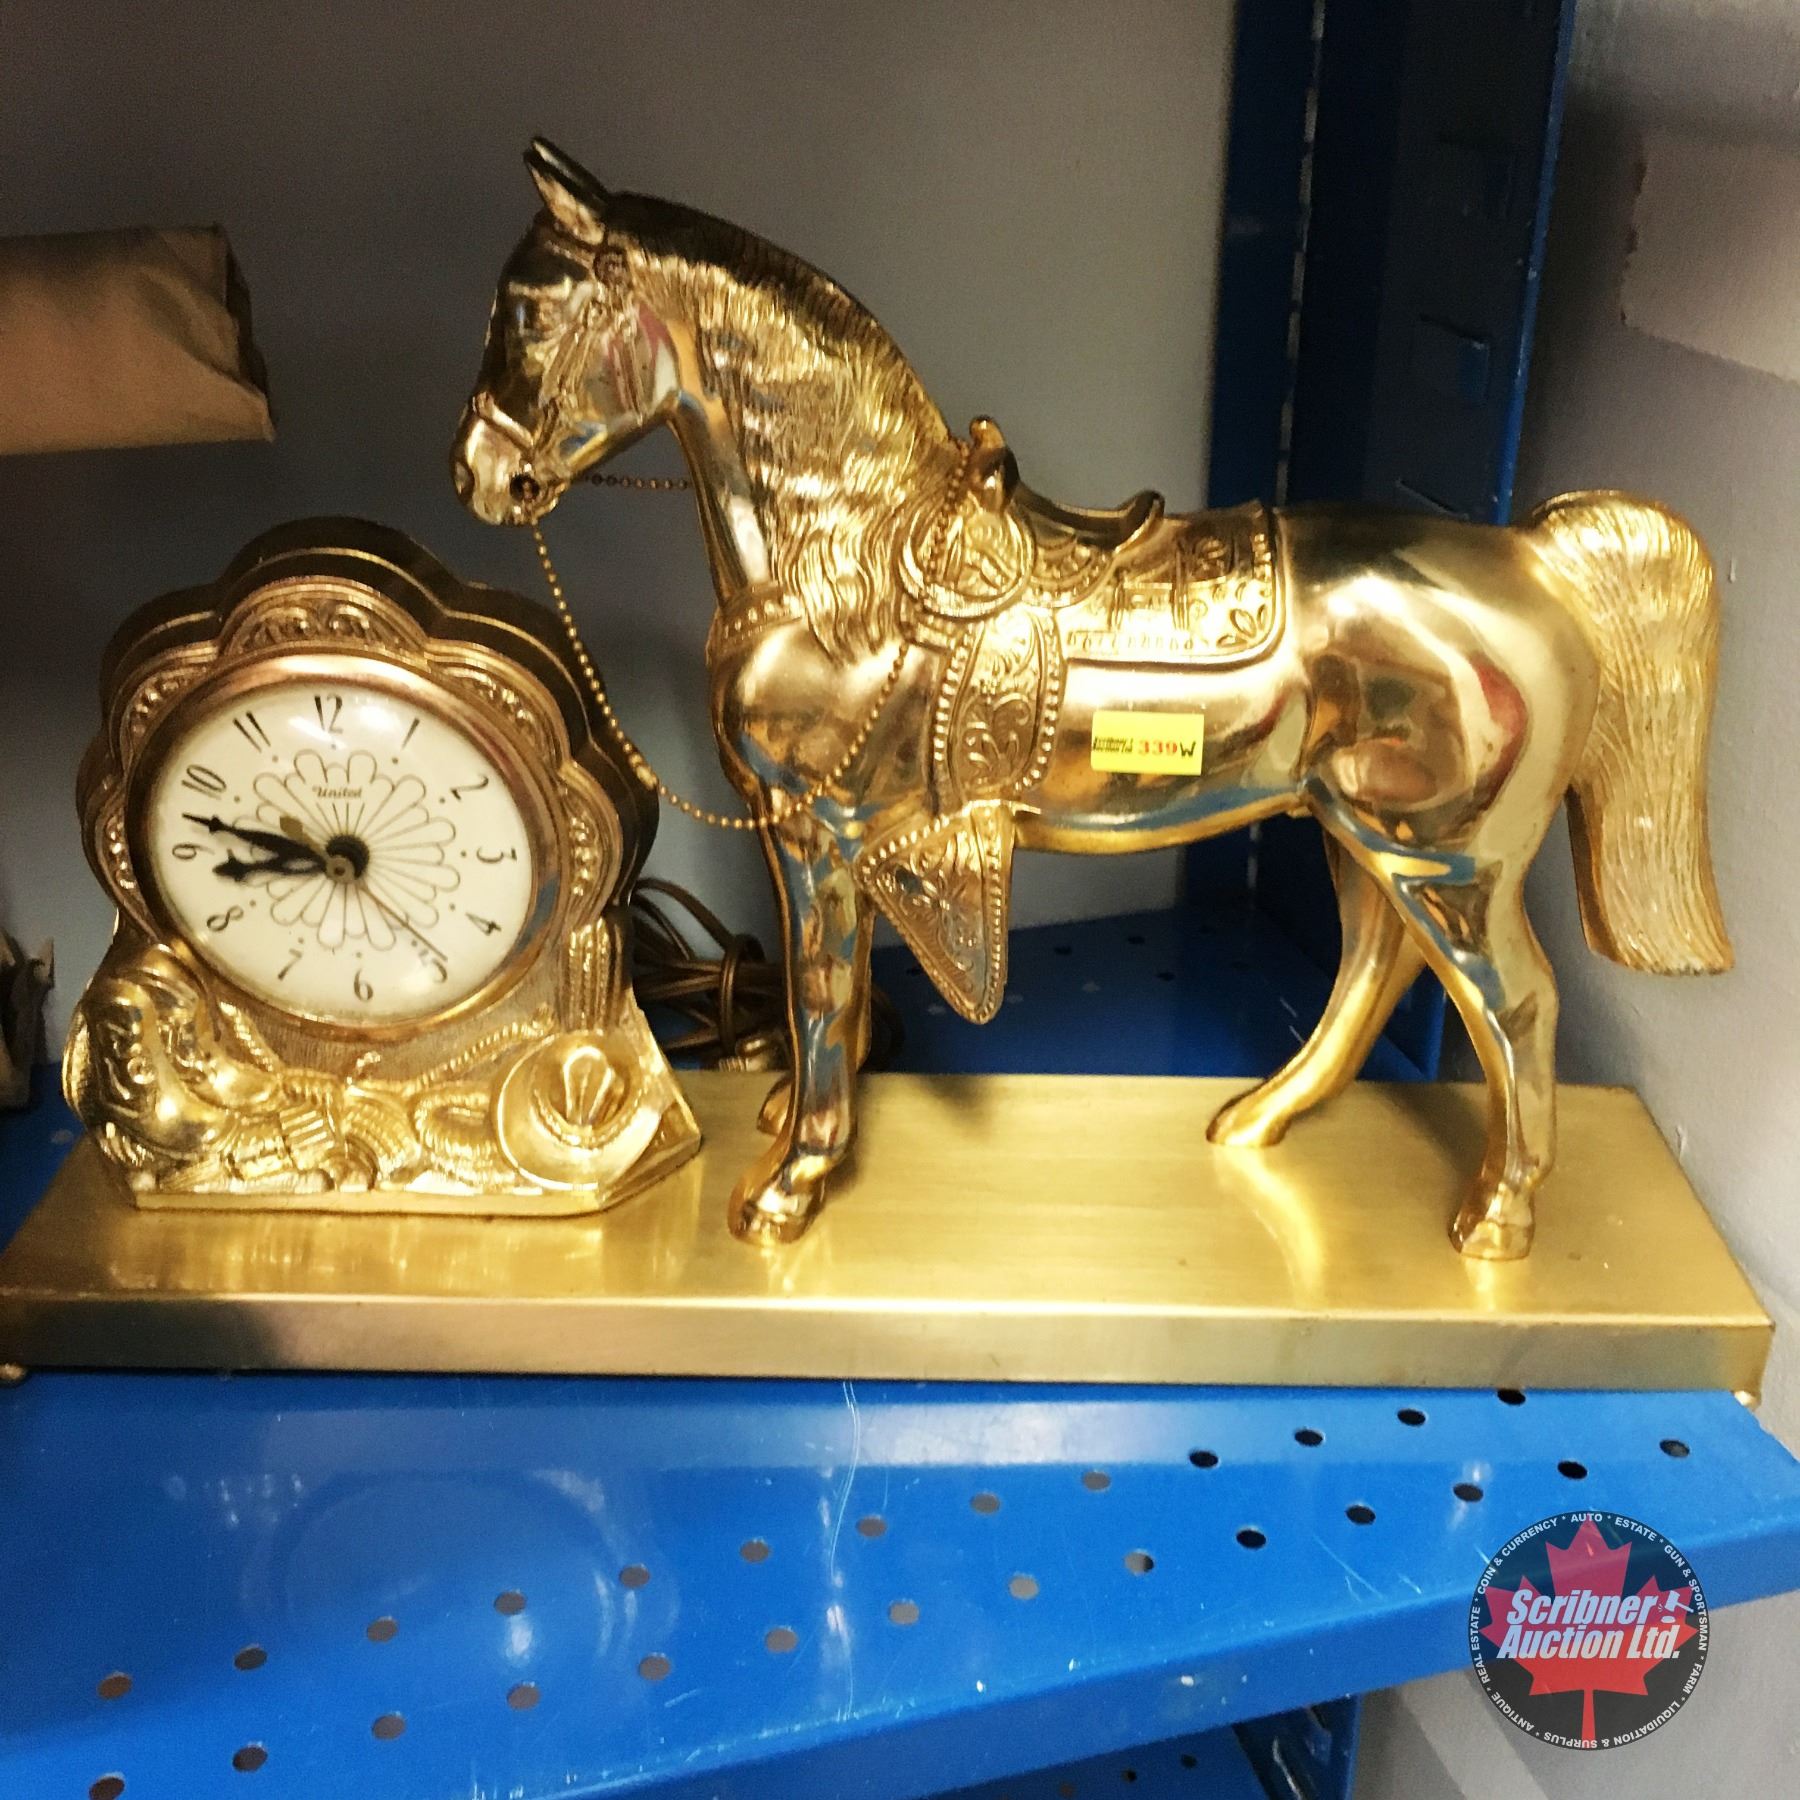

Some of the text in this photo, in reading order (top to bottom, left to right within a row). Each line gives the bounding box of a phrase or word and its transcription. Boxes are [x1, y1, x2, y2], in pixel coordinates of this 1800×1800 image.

[314, 693, 344, 735] 12
[233, 711, 271, 752] 11
[402, 717, 420, 749] 1
[182, 764, 227, 800] 10
[312, 784, 363, 800] United
[449, 773, 489, 801] 2
[171, 843, 213, 861] 9
[476, 846, 517, 865] 3
[206, 904, 244, 933] 8
[464, 910, 502, 938] 4
[277, 947, 303, 981] 7
[418, 948, 448, 984] 5
[353, 970, 374, 1002] 6
